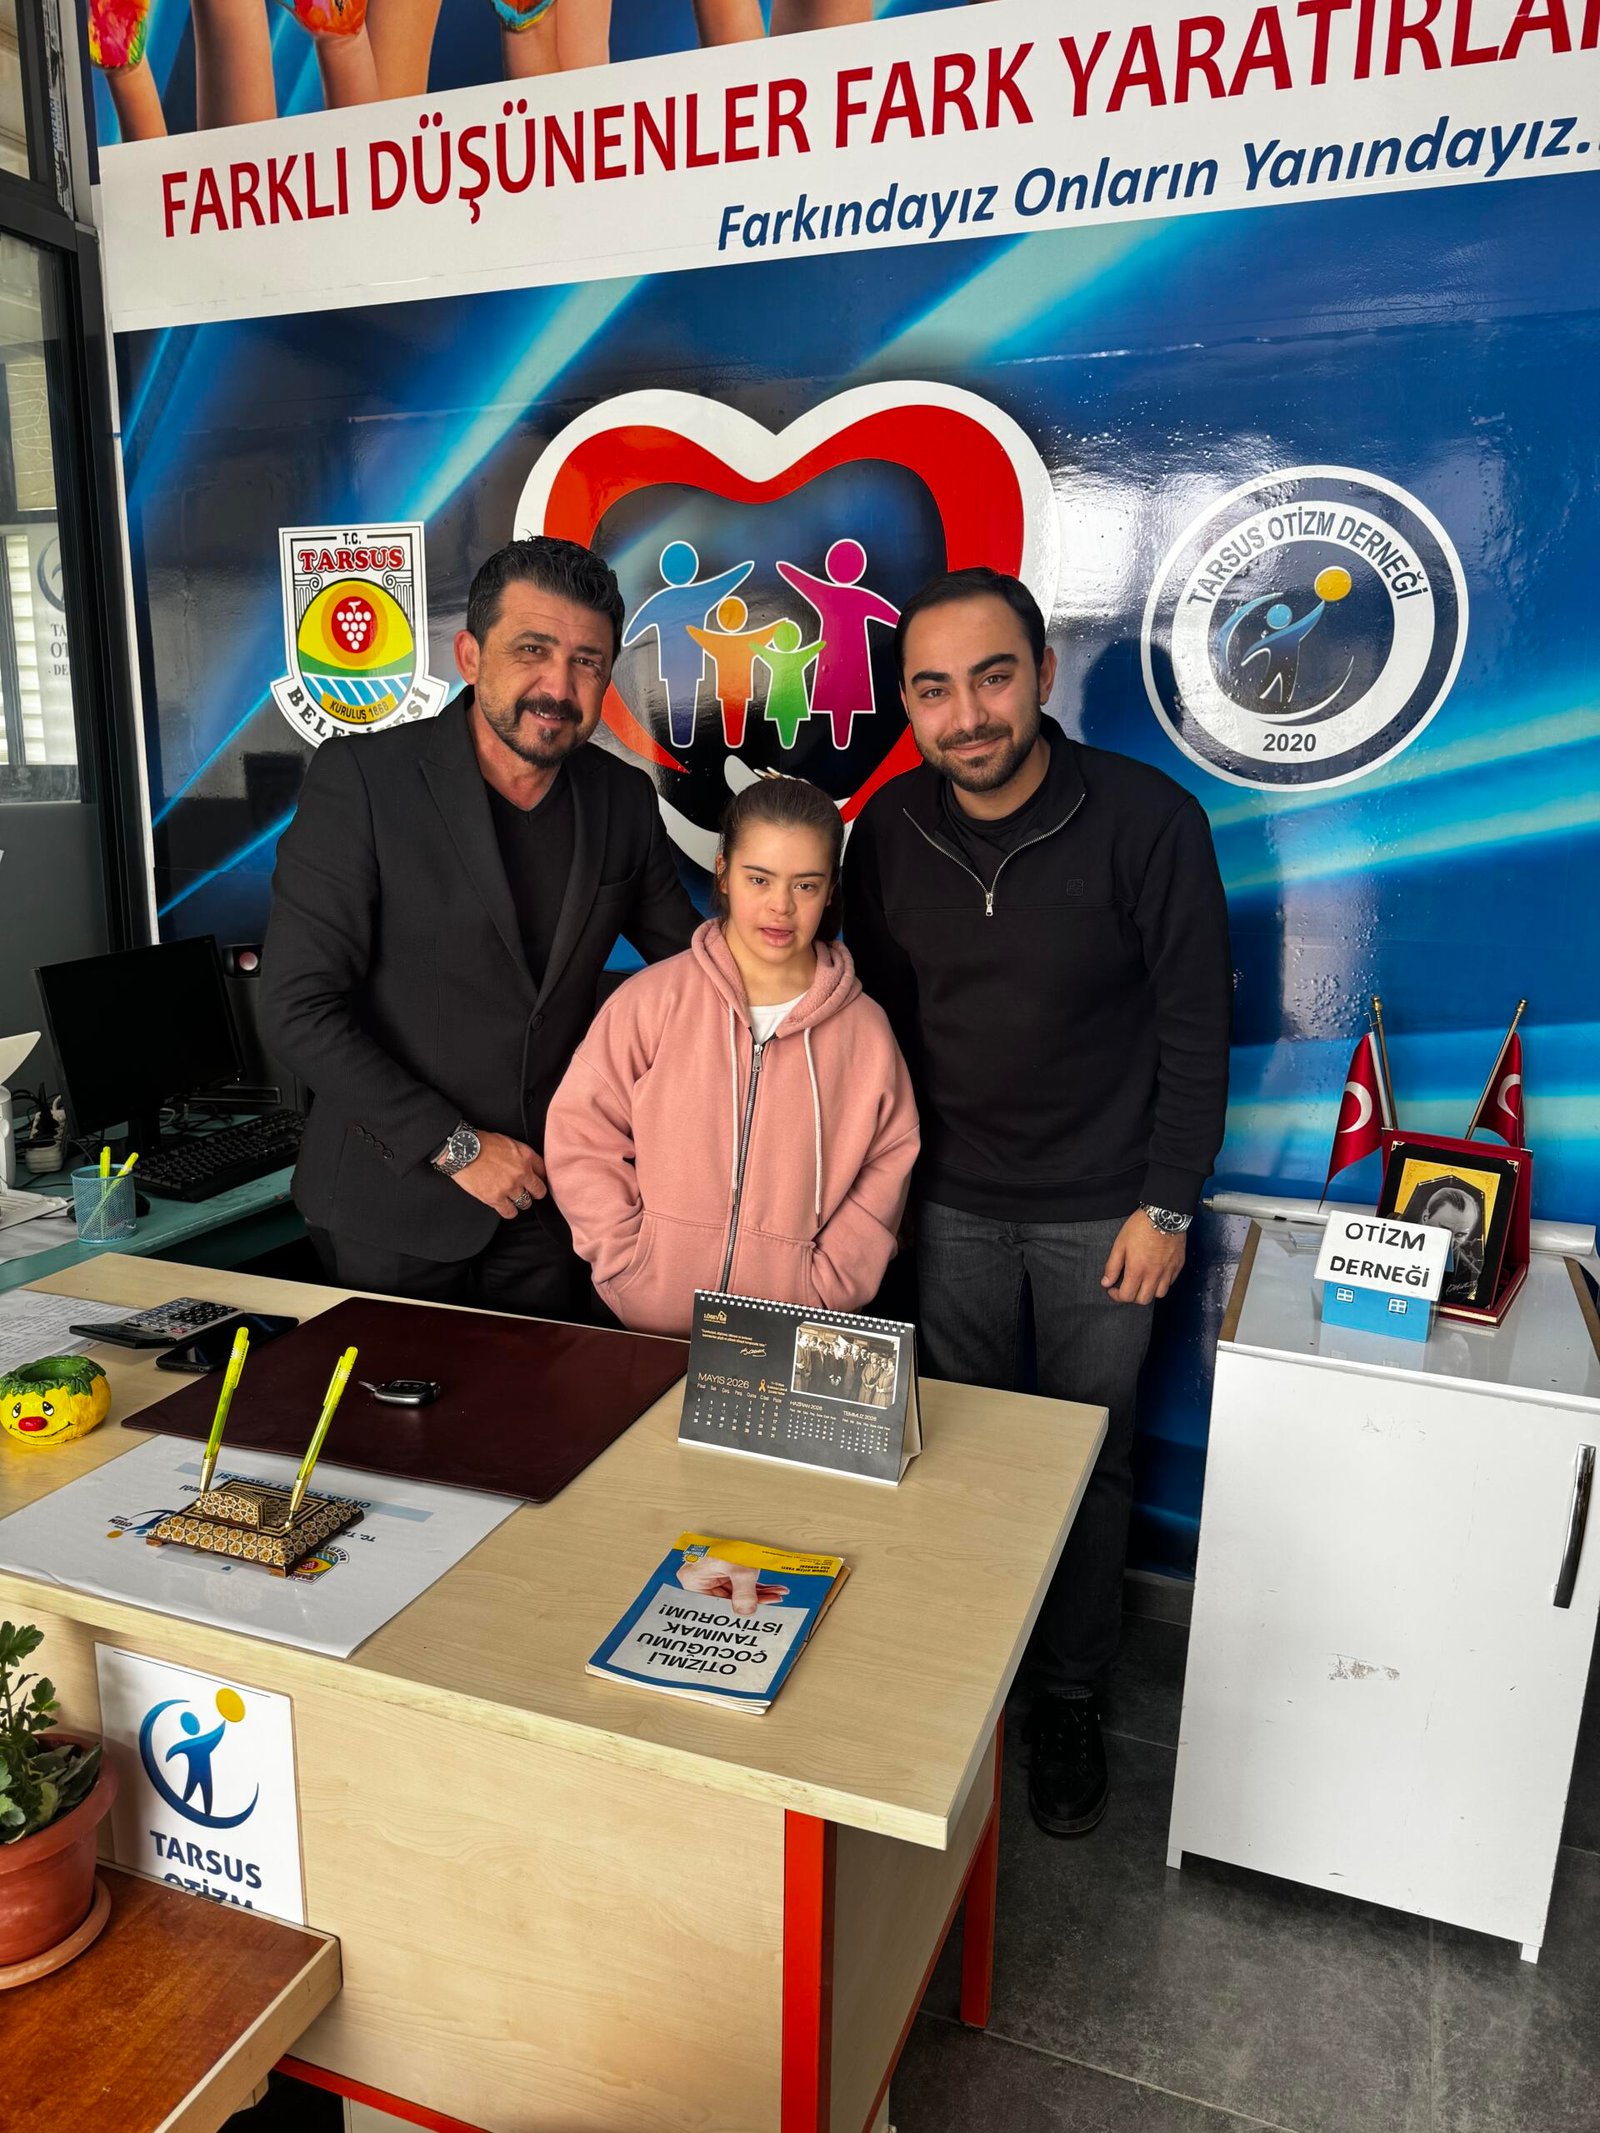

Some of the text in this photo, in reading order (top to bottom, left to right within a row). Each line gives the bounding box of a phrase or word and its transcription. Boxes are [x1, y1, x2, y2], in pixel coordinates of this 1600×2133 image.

[161, 147, 348, 238] FARKLI
[369, 76, 810, 224] DÜŞÜNENLER
[835, 42, 1035, 148] FARK
[717, 115, 1600, 251] Farkındayız Onların Yanındayız.
[342, 532, 362, 545] T.C.
[299, 546, 405, 572] TARSUS
[1187, 506, 1429, 605] TARSUS OTİZM DERNEĞİ
[1262, 733, 1317, 752] 2020
[1345, 1222, 1426, 1252] OTİZM
[1329, 1255, 1431, 1288] DERNEĞİ
[698, 1373, 725, 1385] MAYIS
[726, 1378, 750, 1389] 2026
[658, 1604, 784, 1637] İSTİYORUM!
[662, 1621, 758, 1647] TANIMAK
[637, 1632, 768, 1664] ÇOCUĞUMU
[647, 1651, 738, 1675] OTİZMLİ
[150, 1830, 263, 1889] TARSUS
